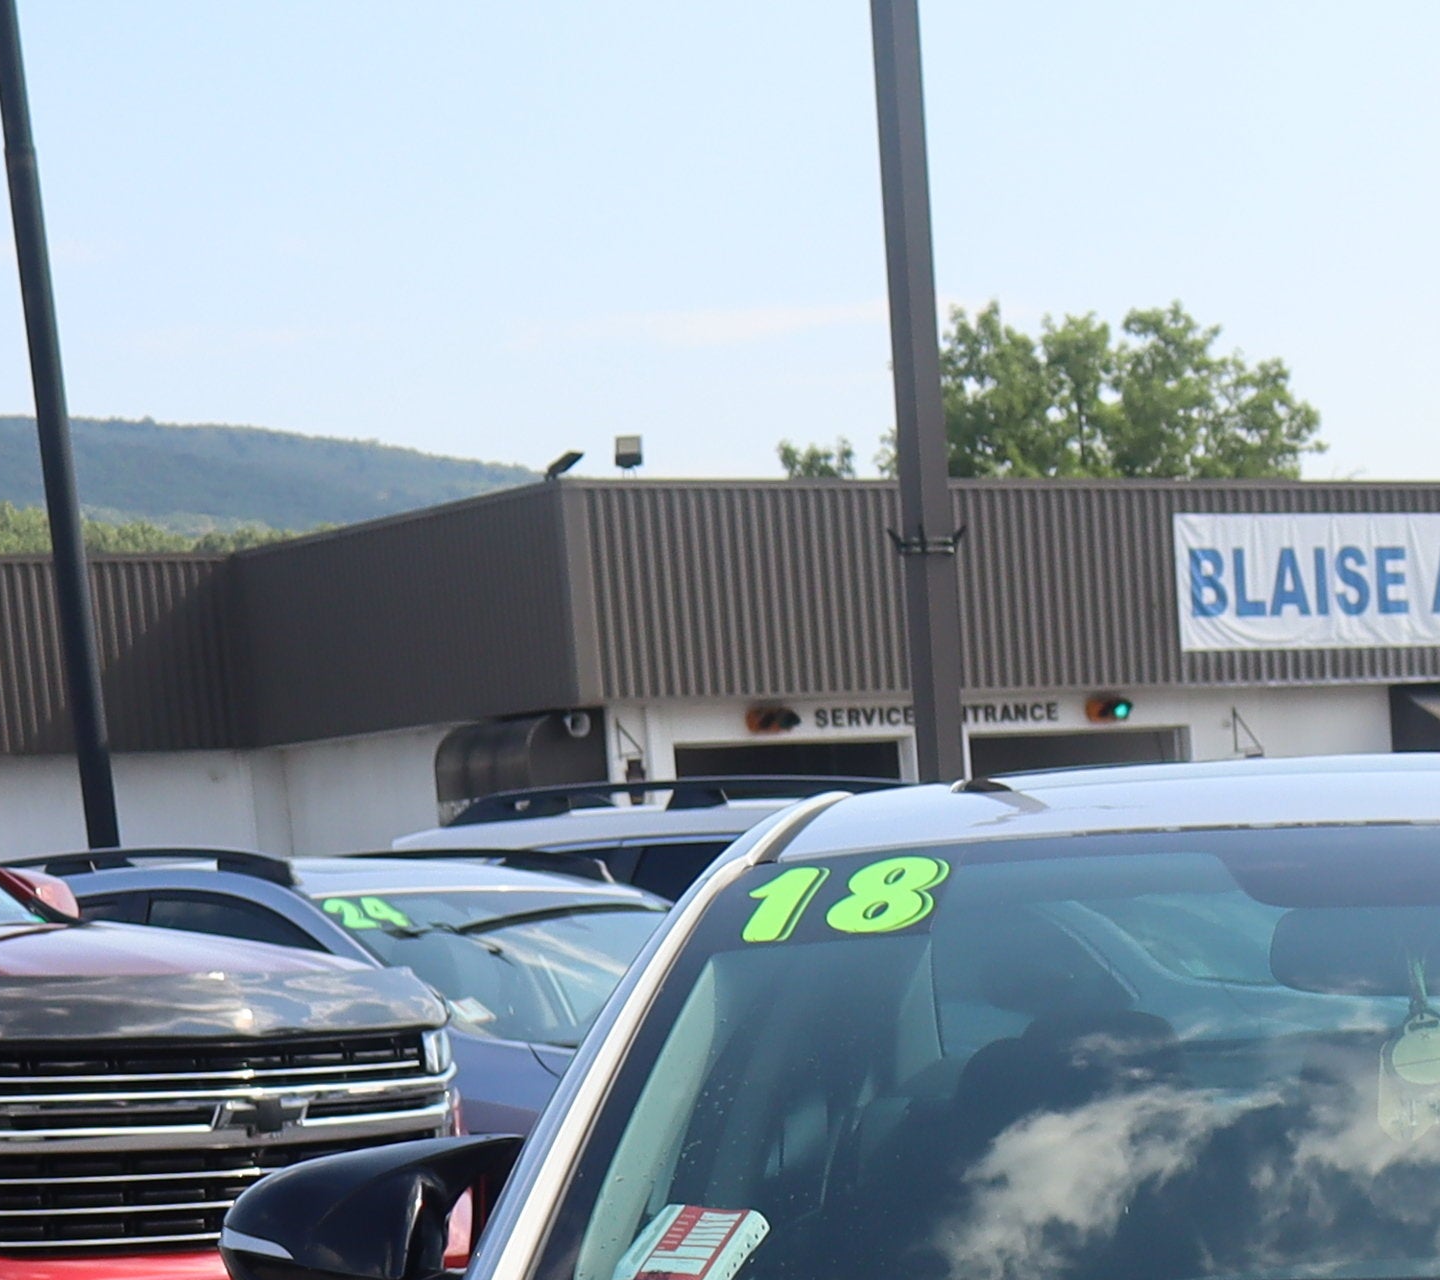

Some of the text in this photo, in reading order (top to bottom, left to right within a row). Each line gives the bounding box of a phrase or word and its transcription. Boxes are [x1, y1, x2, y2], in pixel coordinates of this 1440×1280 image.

[1188, 545, 1409, 617] BLAISE
[814, 706, 914, 728] SERVICE
[323, 897, 414, 929] 24
[741, 856, 951, 943] 18
